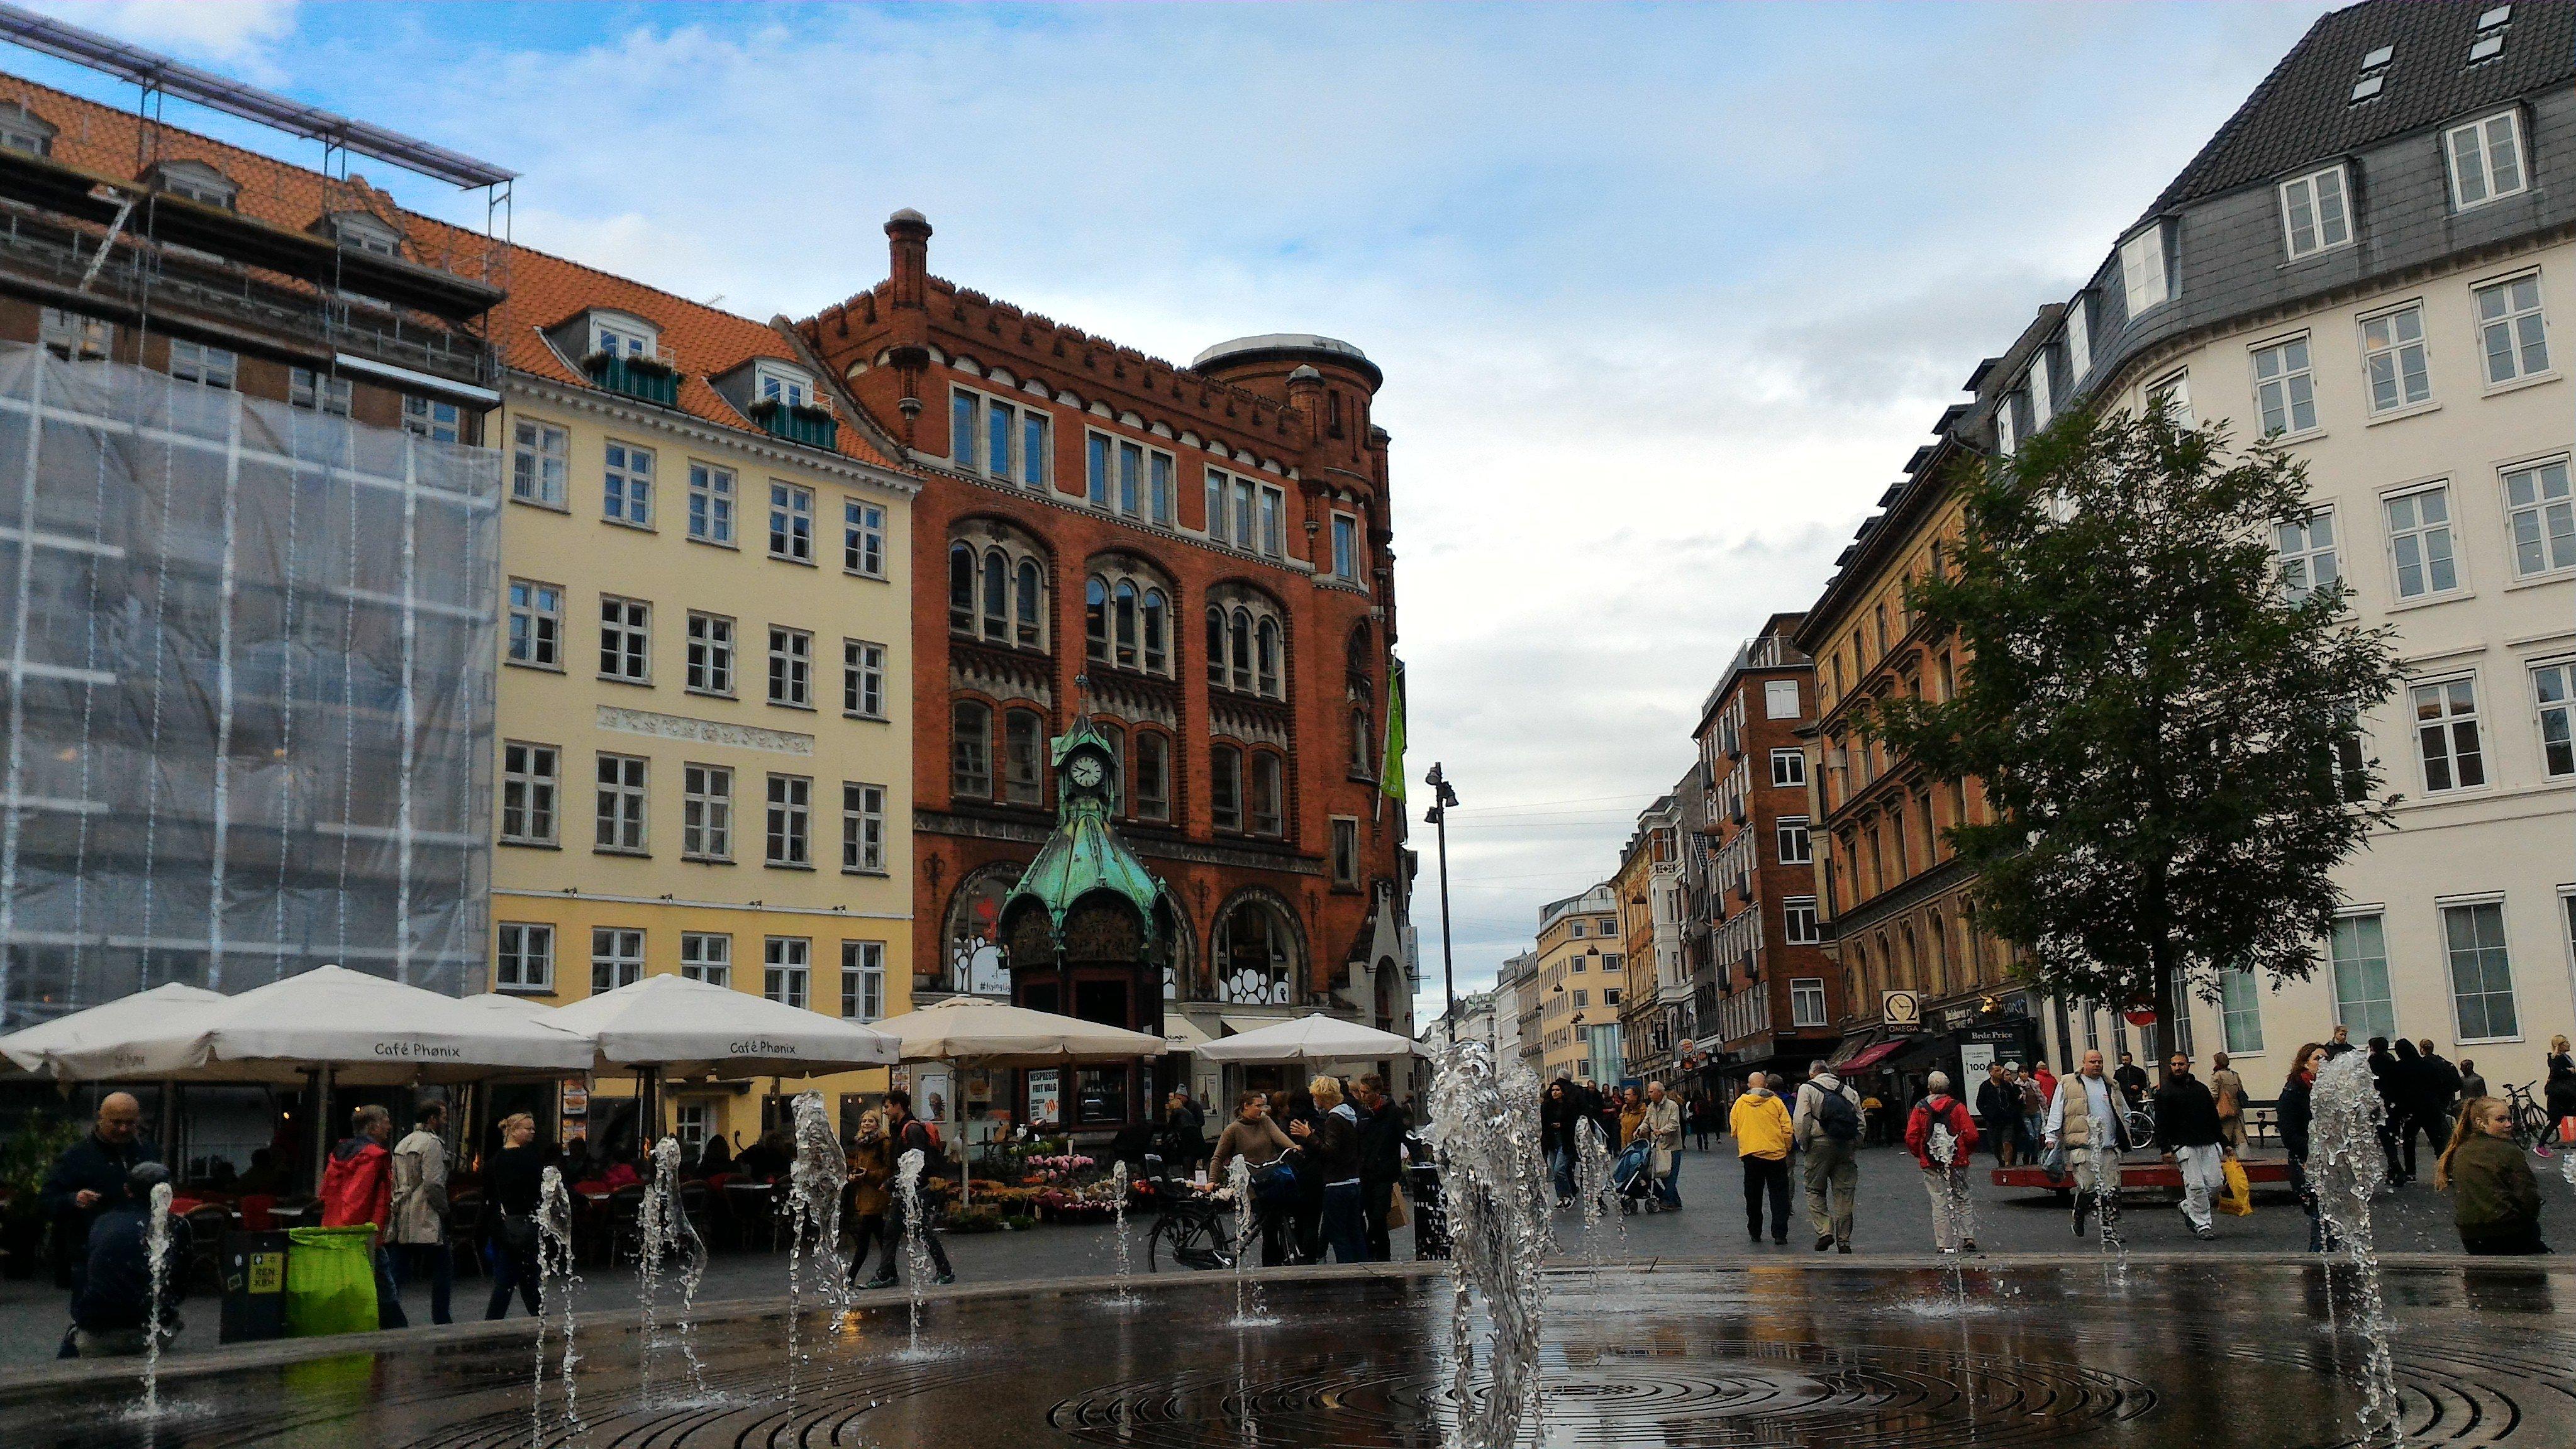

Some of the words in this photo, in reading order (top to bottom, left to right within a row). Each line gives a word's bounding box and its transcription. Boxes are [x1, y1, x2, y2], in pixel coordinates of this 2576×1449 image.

[375, 1043, 408, 1056] Café
[413, 1043, 460, 1057] Phønix
[730, 1040, 758, 1053] Café
[761, 1041, 796, 1054] Phønix
